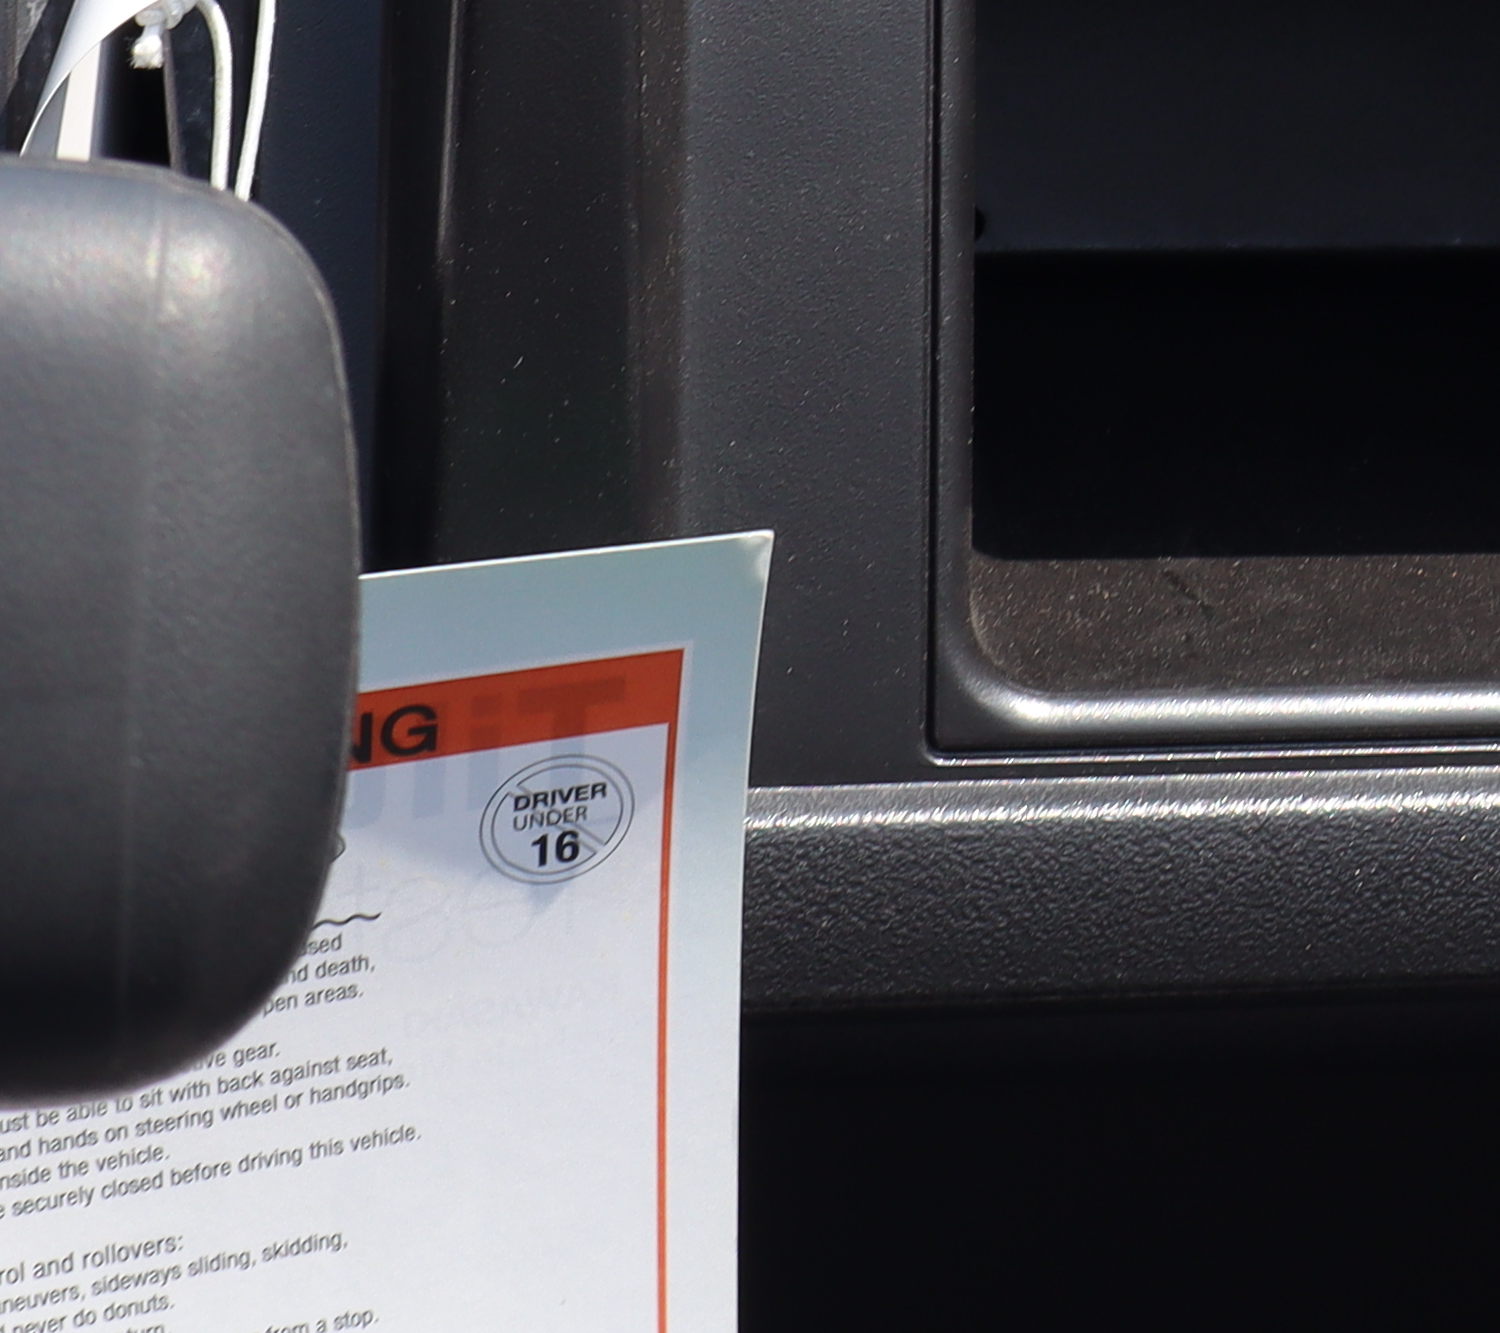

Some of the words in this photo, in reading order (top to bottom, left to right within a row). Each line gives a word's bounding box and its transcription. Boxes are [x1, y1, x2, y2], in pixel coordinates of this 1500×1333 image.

[513, 782, 607, 812] DRIVER
[513, 805, 588, 832] UNDER
[531, 829, 581, 867] 16
[315, 956, 375, 981] death,
[305, 982, 364, 1008] areas.
[233, 1041, 280, 1069] gear.
[36, 1106, 60, 1128] be
[67, 1099, 108, 1121] able
[115, 1096, 134, 1113] to
[140, 1086, 164, 1110] sit
[169, 1080, 211, 1106] with
[217, 1069, 265, 1096] back
[270, 1056, 341, 1087] against
[345, 1046, 393, 1073] seat,
[38, 1127, 100, 1156] hands
[105, 1123, 129, 1143] on
[135, 1107, 215, 1139] steering
[220, 1094, 278, 1122] wheel
[284, 1089, 304, 1111] or
[310, 1071, 411, 1107] handgrips.
[12, 1185, 96, 1219] securely
[100, 1172, 164, 1201] closed
[171, 1157, 232, 1188] before
[238, 1145, 303, 1175] driving
[310, 1134, 345, 1160] this
[350, 1122, 422, 1153] vehicle.
[58, 1152, 90, 1176] the
[98, 1144, 170, 1173] vehicle.
[33, 1250, 75, 1278] and
[82, 1232, 185, 1270] rollovers:
[91, 1260, 184, 1298] sideways
[188, 1247, 257, 1279] sliding,
[261, 1231, 349, 1263] skidding,
[73, 1307, 98, 1328] do
[103, 1292, 176, 1323] donuts.
[333, 1308, 381, 1331] stop.
